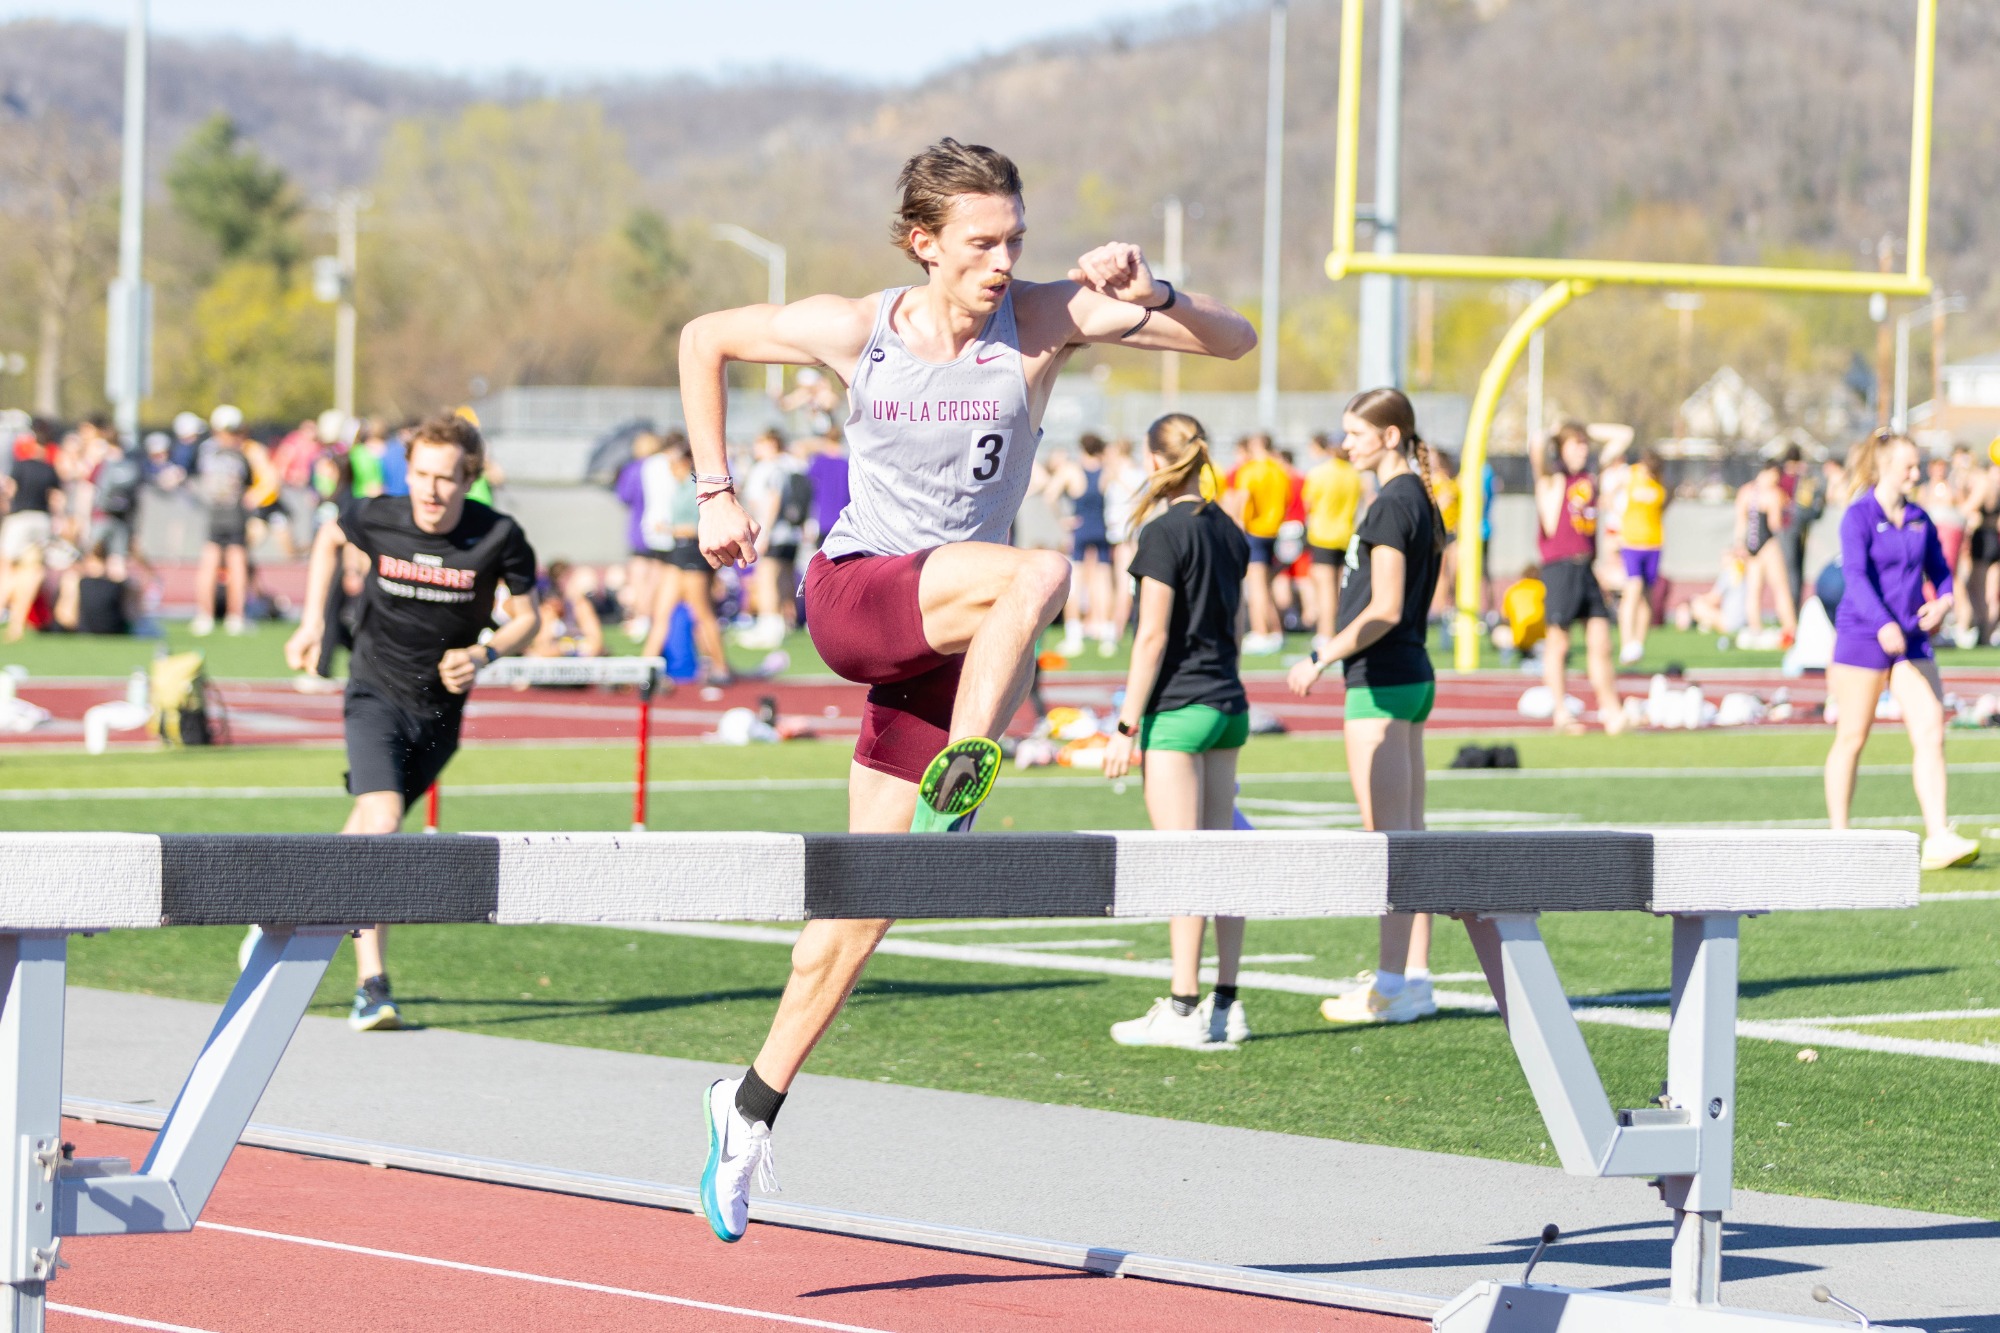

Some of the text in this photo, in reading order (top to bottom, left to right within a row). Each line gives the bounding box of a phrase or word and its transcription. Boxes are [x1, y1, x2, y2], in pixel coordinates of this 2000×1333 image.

[871, 351, 884, 360] DF
[873, 399, 1000, 421] UW-LA CROSSE
[972, 433, 1004, 481] 3
[378, 554, 477, 589] RAIDERS
